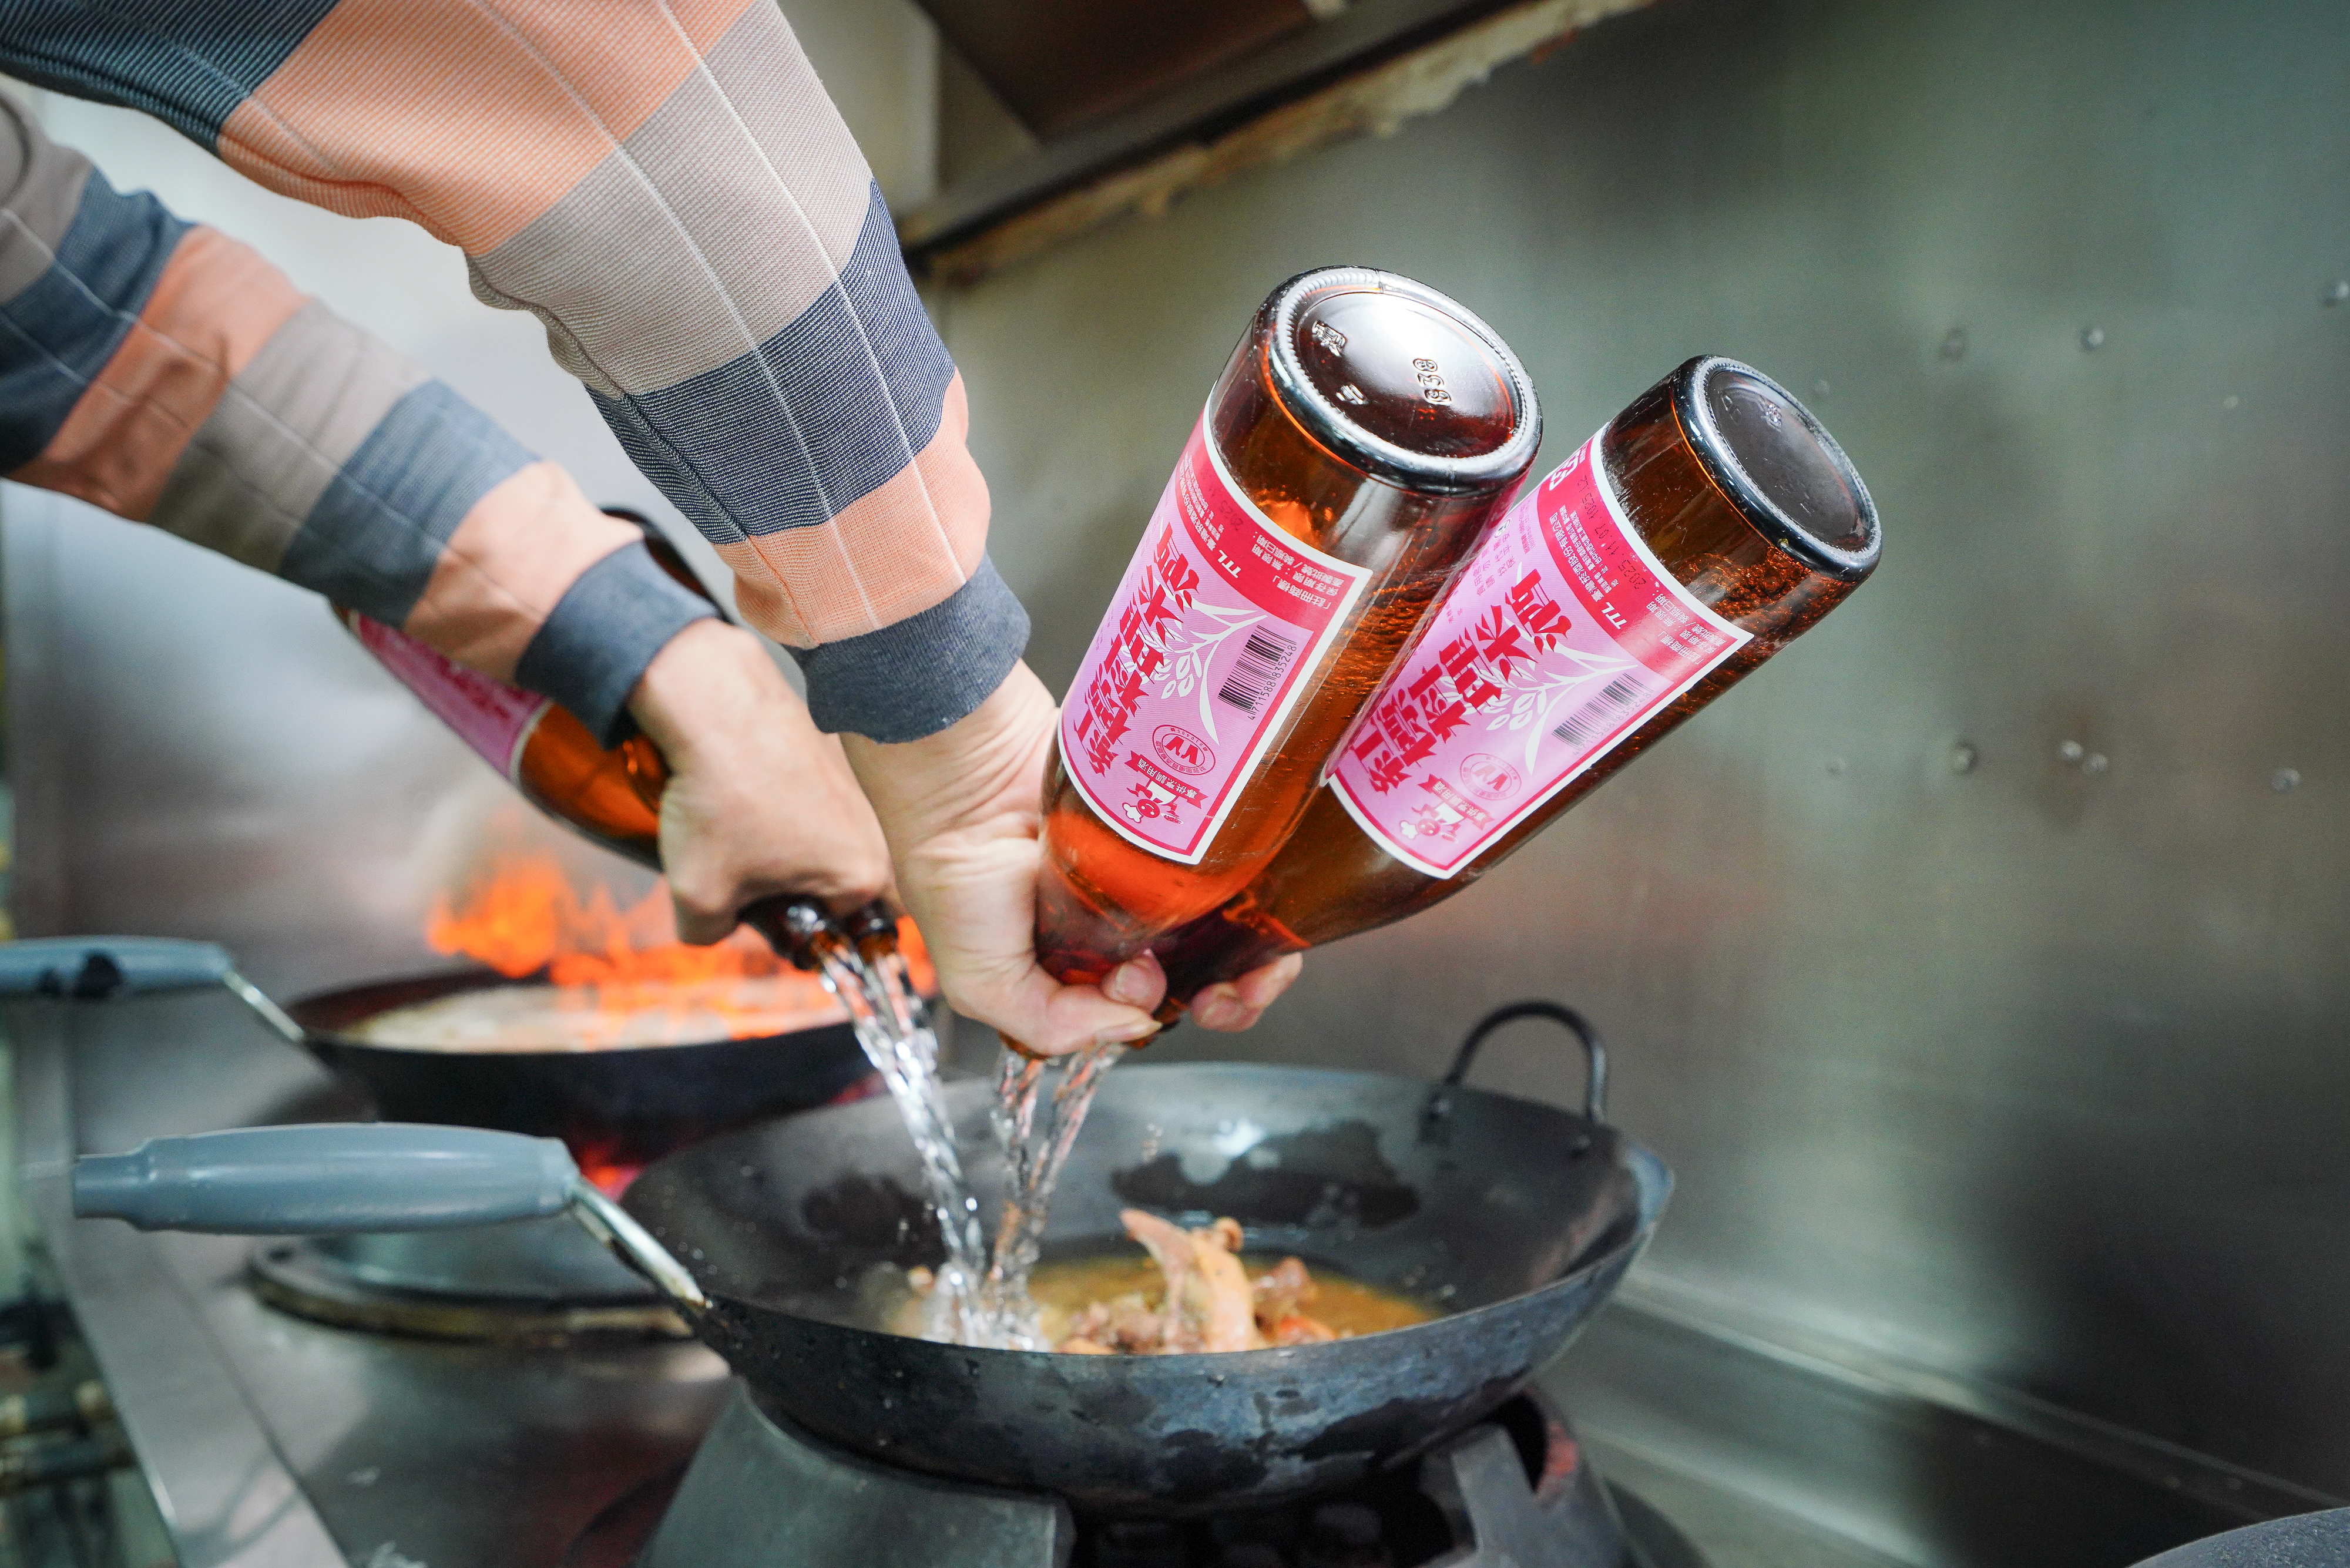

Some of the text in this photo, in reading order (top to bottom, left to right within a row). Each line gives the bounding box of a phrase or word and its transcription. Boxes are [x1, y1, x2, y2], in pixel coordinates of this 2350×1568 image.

[1217, 549, 1241, 577] TTL
[1548, 512, 1604, 602] 臺灣菸酒股份有限公司
[1600, 601, 1627, 629] TTL
[1073, 522, 1199, 776] 紅標料理米酒
[1349, 569, 1573, 795] 紅標料理米酒
[1136, 758, 1197, 798] 專供烹調用酒
